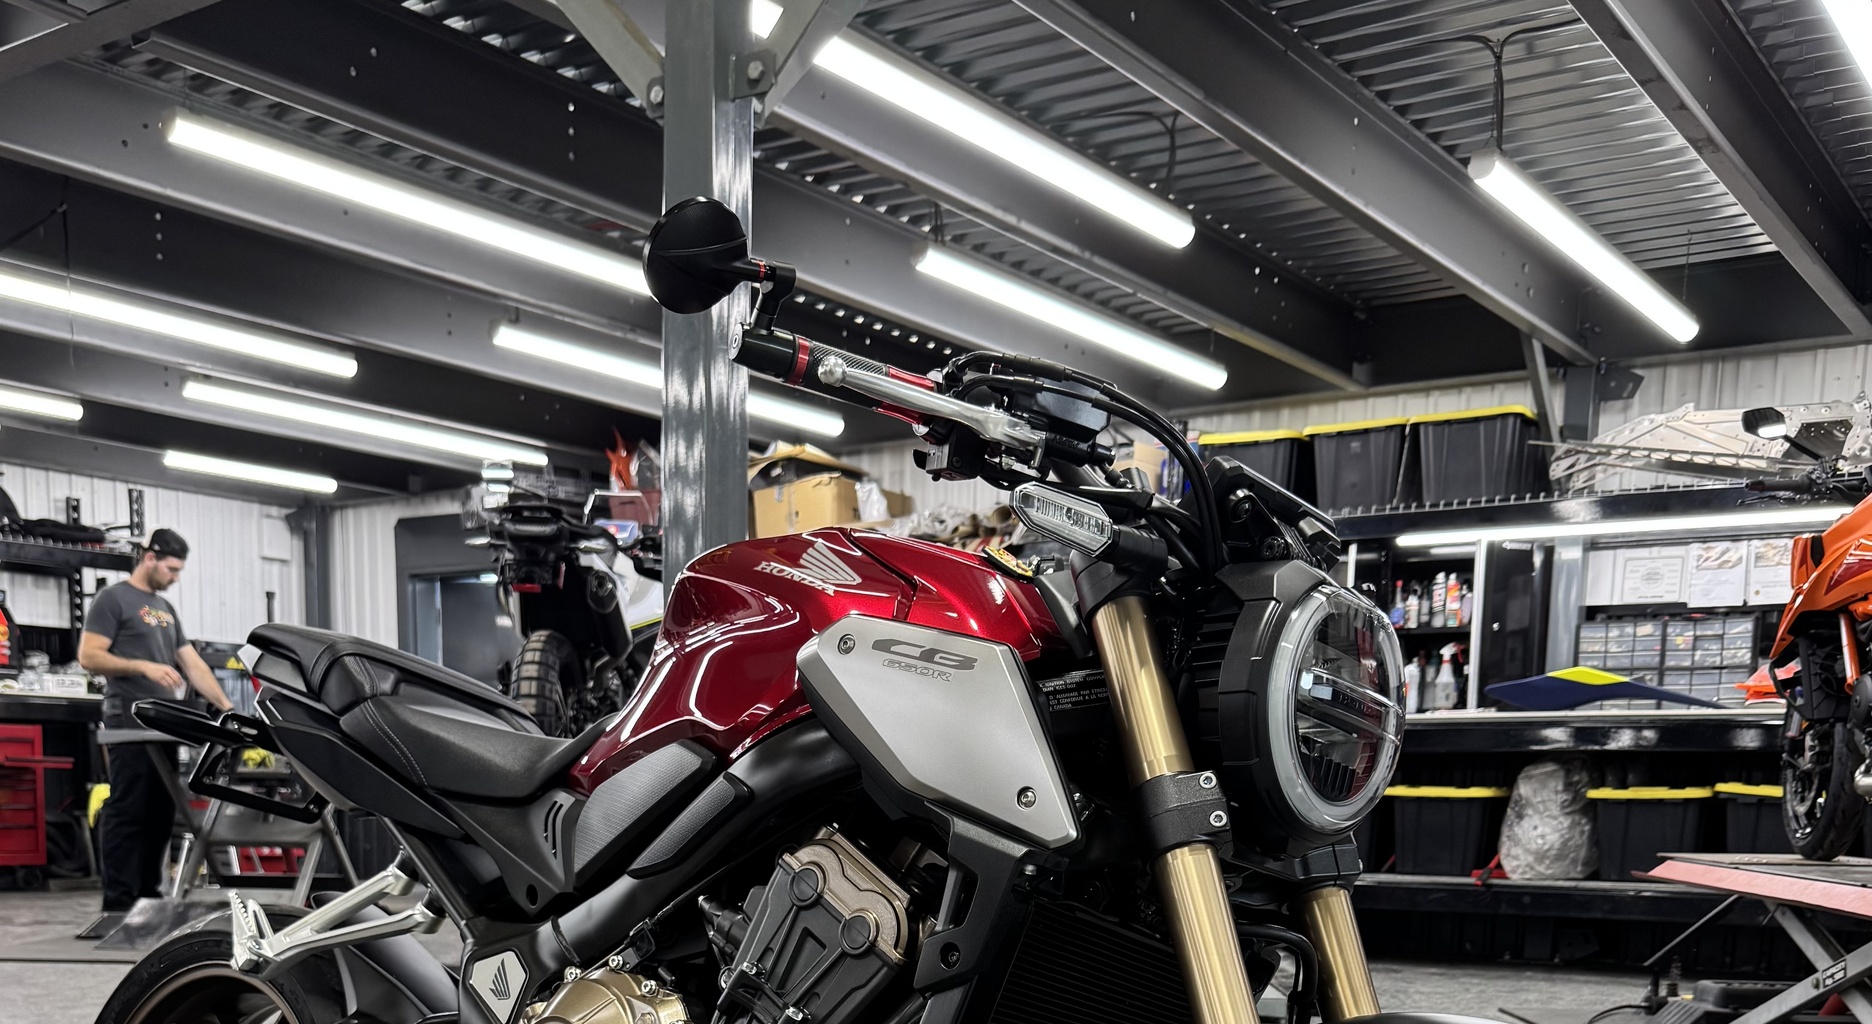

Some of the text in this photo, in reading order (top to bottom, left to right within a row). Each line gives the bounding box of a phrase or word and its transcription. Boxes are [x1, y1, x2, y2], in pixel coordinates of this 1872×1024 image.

[754, 561, 835, 596] HONDA
[872, 638, 978, 671] CB
[882, 658, 952, 682] 650R
